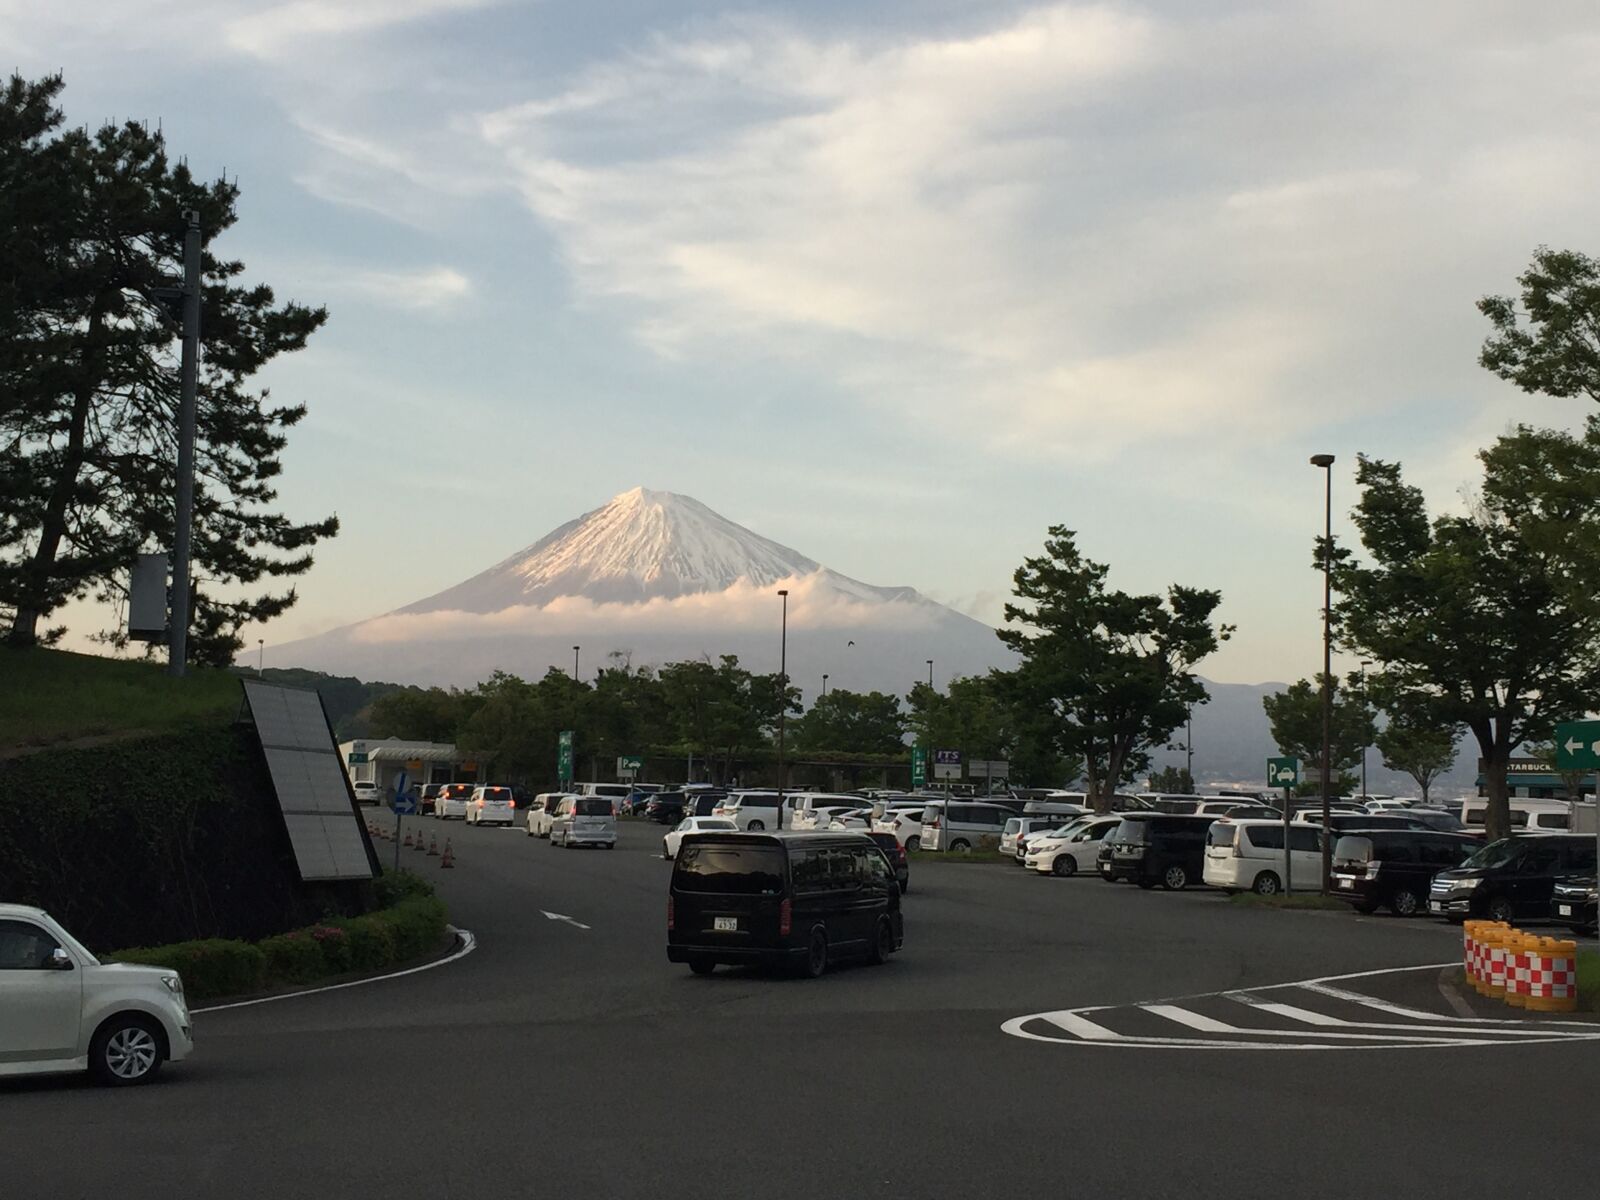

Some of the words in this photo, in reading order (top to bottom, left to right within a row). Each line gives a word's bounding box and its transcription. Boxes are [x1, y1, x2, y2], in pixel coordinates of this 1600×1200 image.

[938, 750, 960, 760] ITS
[623, 758, 629, 769] P
[1507, 763, 1553, 771] TARBUCK
[1269, 763, 1277, 783] P
